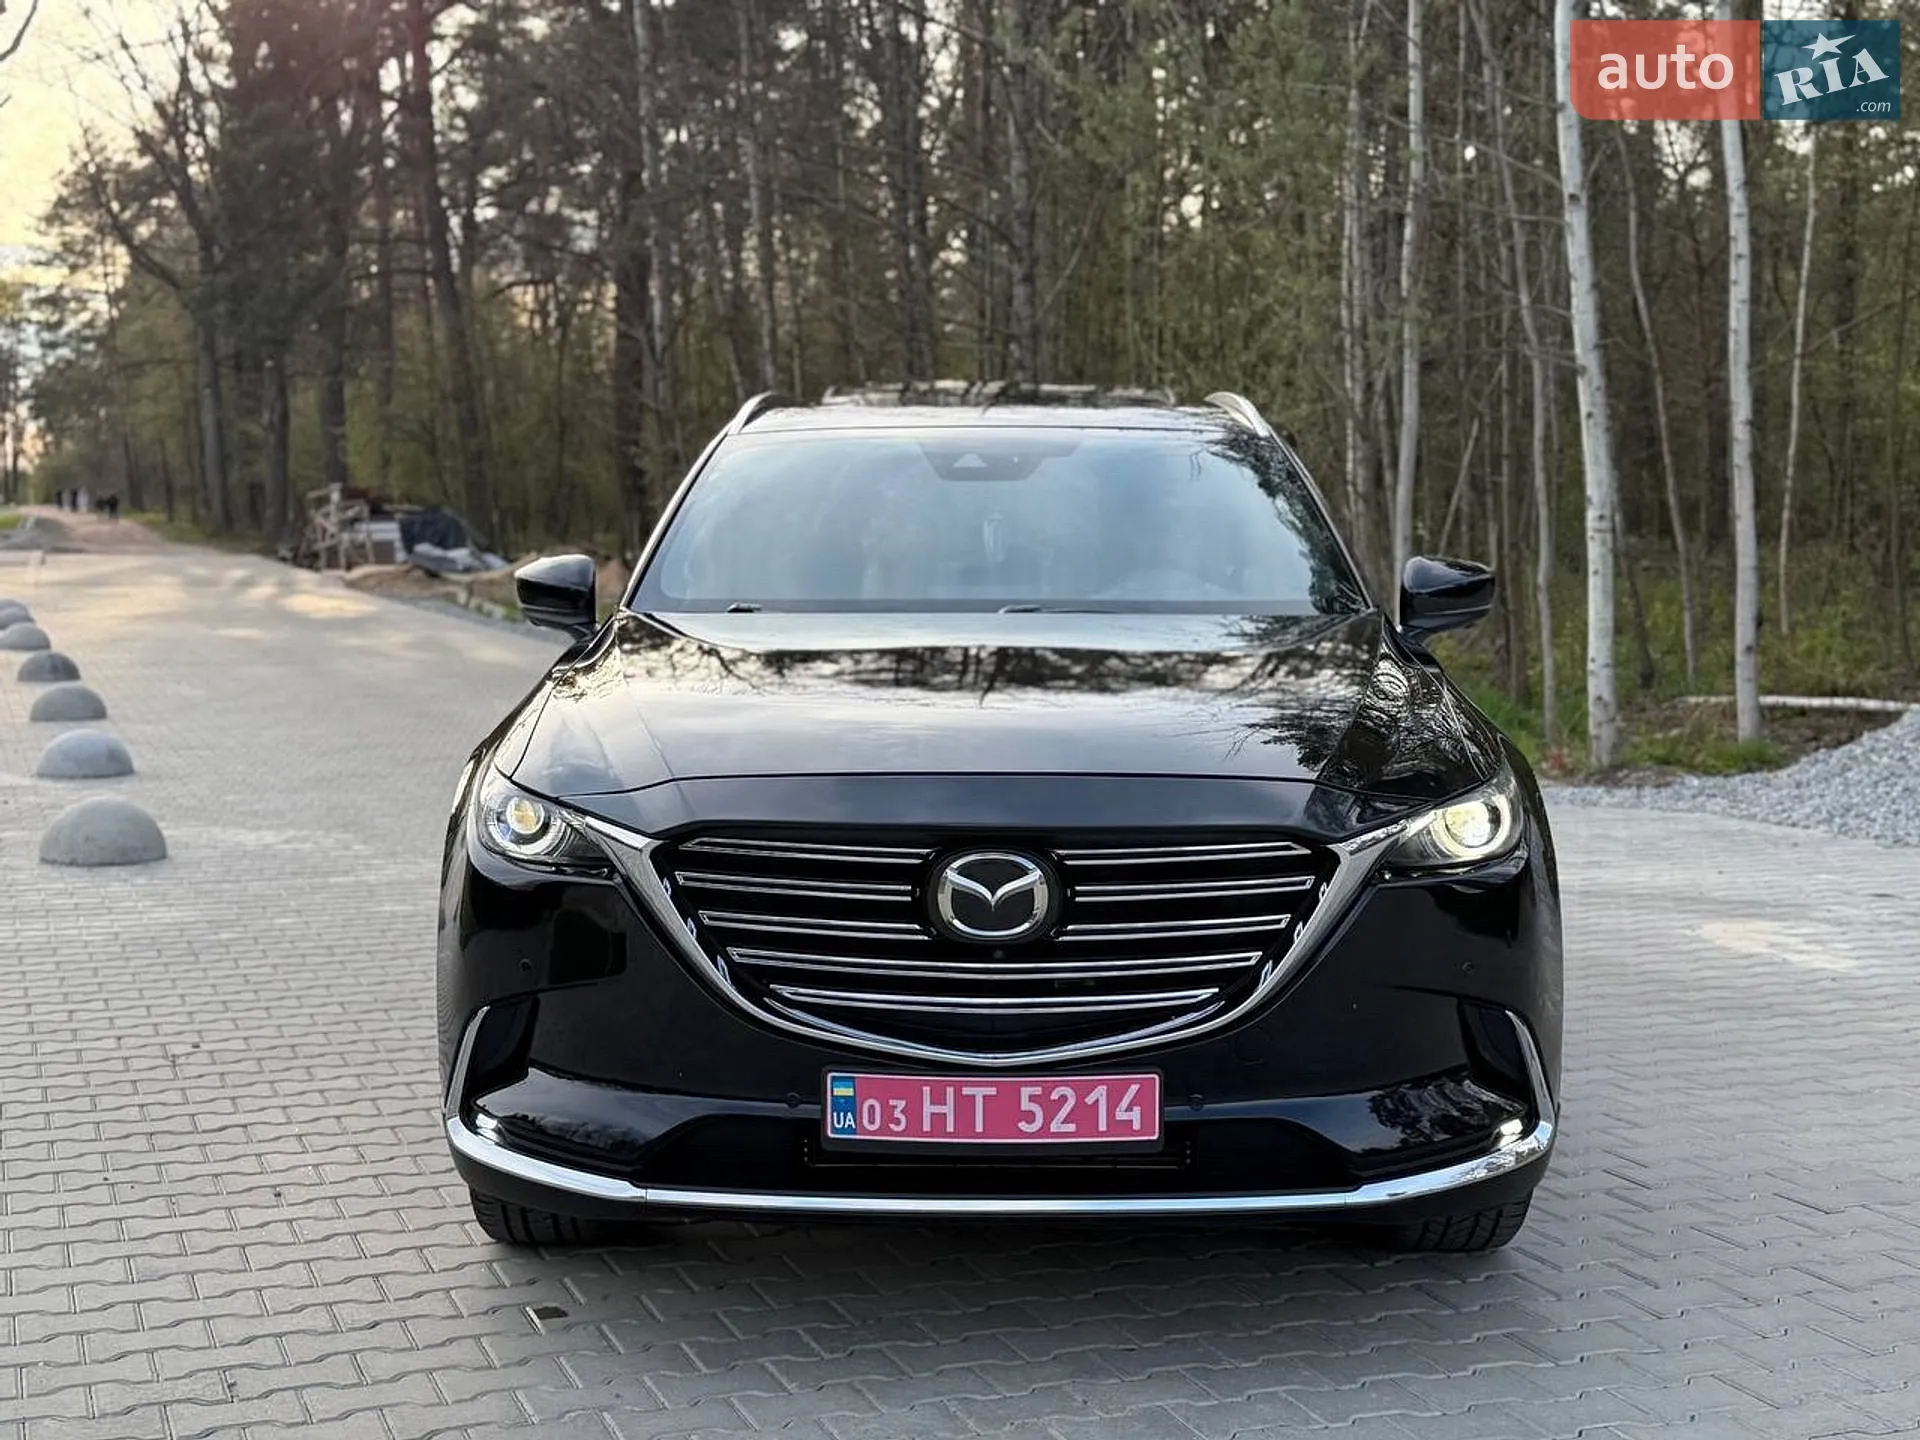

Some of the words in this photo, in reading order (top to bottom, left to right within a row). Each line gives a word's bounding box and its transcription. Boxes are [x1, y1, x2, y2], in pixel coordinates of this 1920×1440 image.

[833, 1112, 856, 1129] UA
[861, 1098, 907, 1132] 03
[921, 1085, 997, 1133] HT
[1017, 1083, 1142, 1133] 5214
